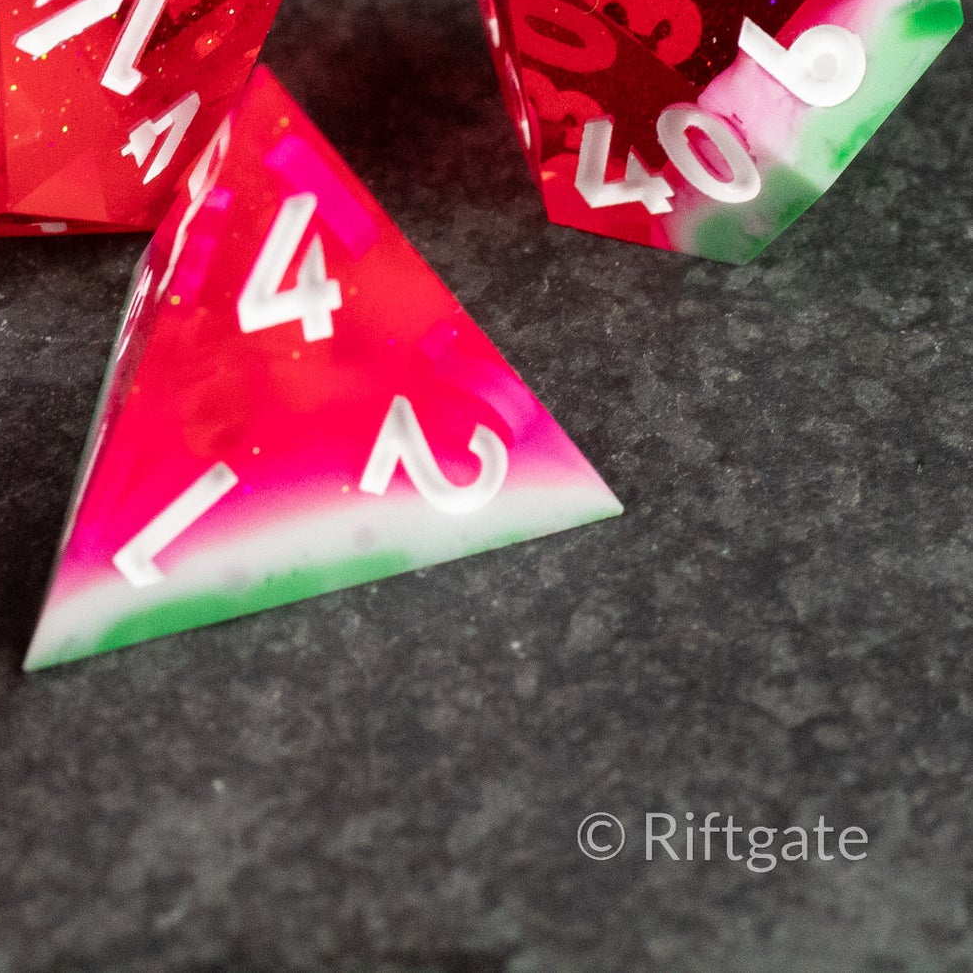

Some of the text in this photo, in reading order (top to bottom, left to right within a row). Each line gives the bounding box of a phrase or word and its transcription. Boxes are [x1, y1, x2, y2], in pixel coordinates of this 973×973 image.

[574, 102, 761, 214] 40
[237, 192, 343, 342] 4
[358, 394, 509, 515] 2
[112, 461, 239, 588] 1
